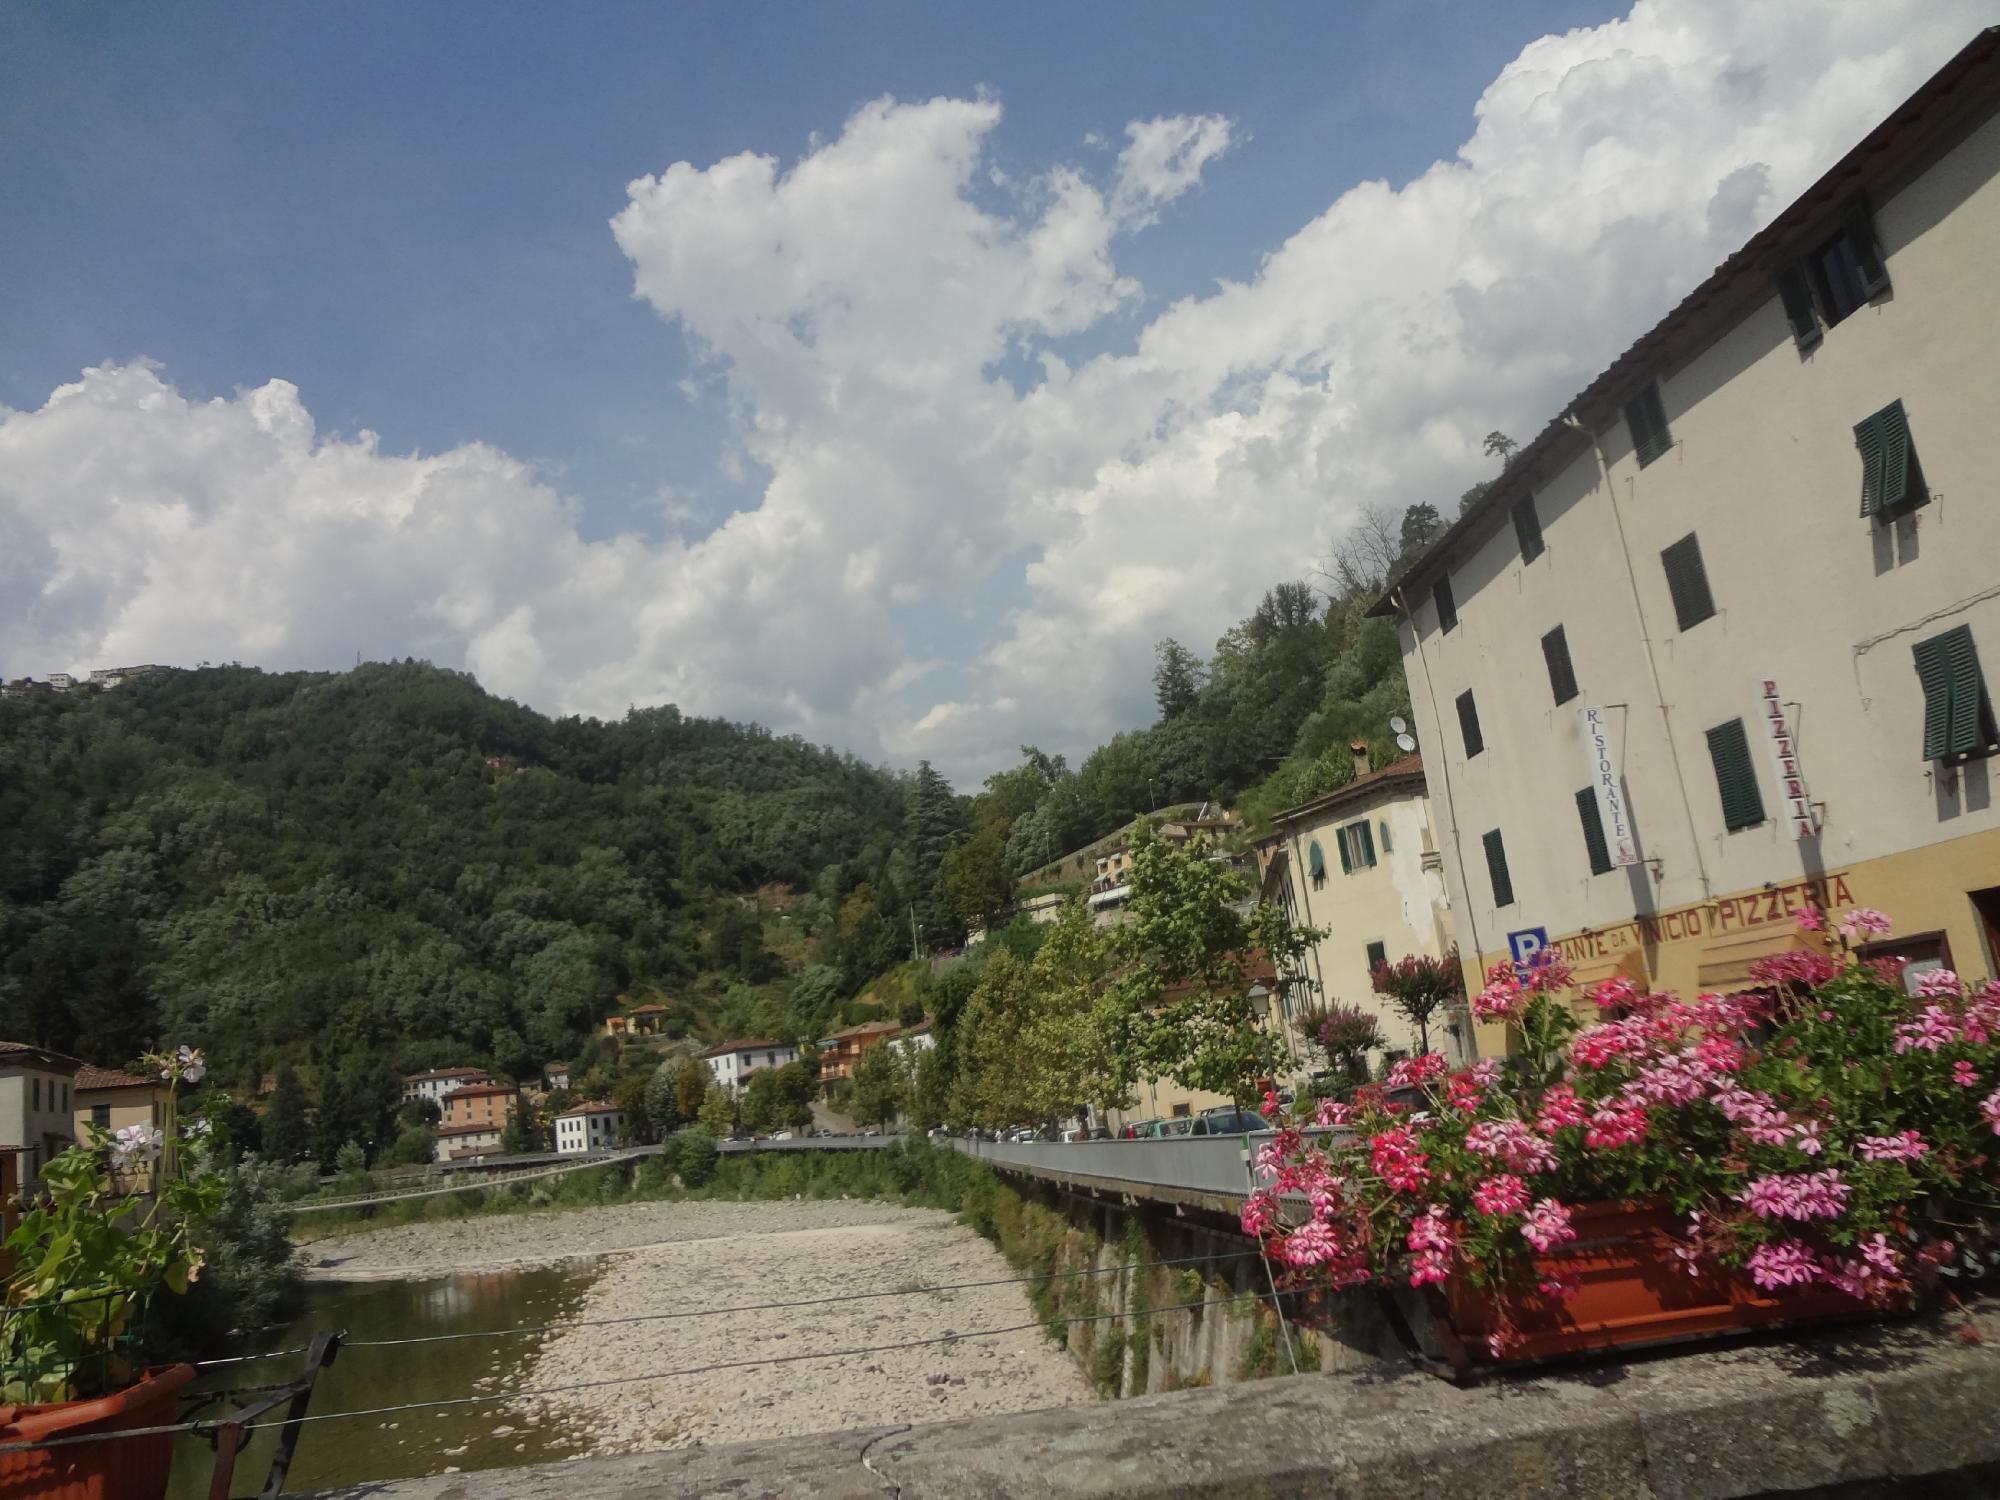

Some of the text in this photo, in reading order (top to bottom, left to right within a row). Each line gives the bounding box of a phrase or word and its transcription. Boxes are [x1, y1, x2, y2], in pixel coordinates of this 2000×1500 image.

[1587, 709, 1626, 837] RISTORANTE
[1763, 681, 1811, 836] PIZZERIA
[1515, 933, 1541, 963] P
[1611, 931, 1628, 948] DA
[1631, 910, 1702, 945] VINICIO
[1718, 875, 1855, 929] PIZZERIA
